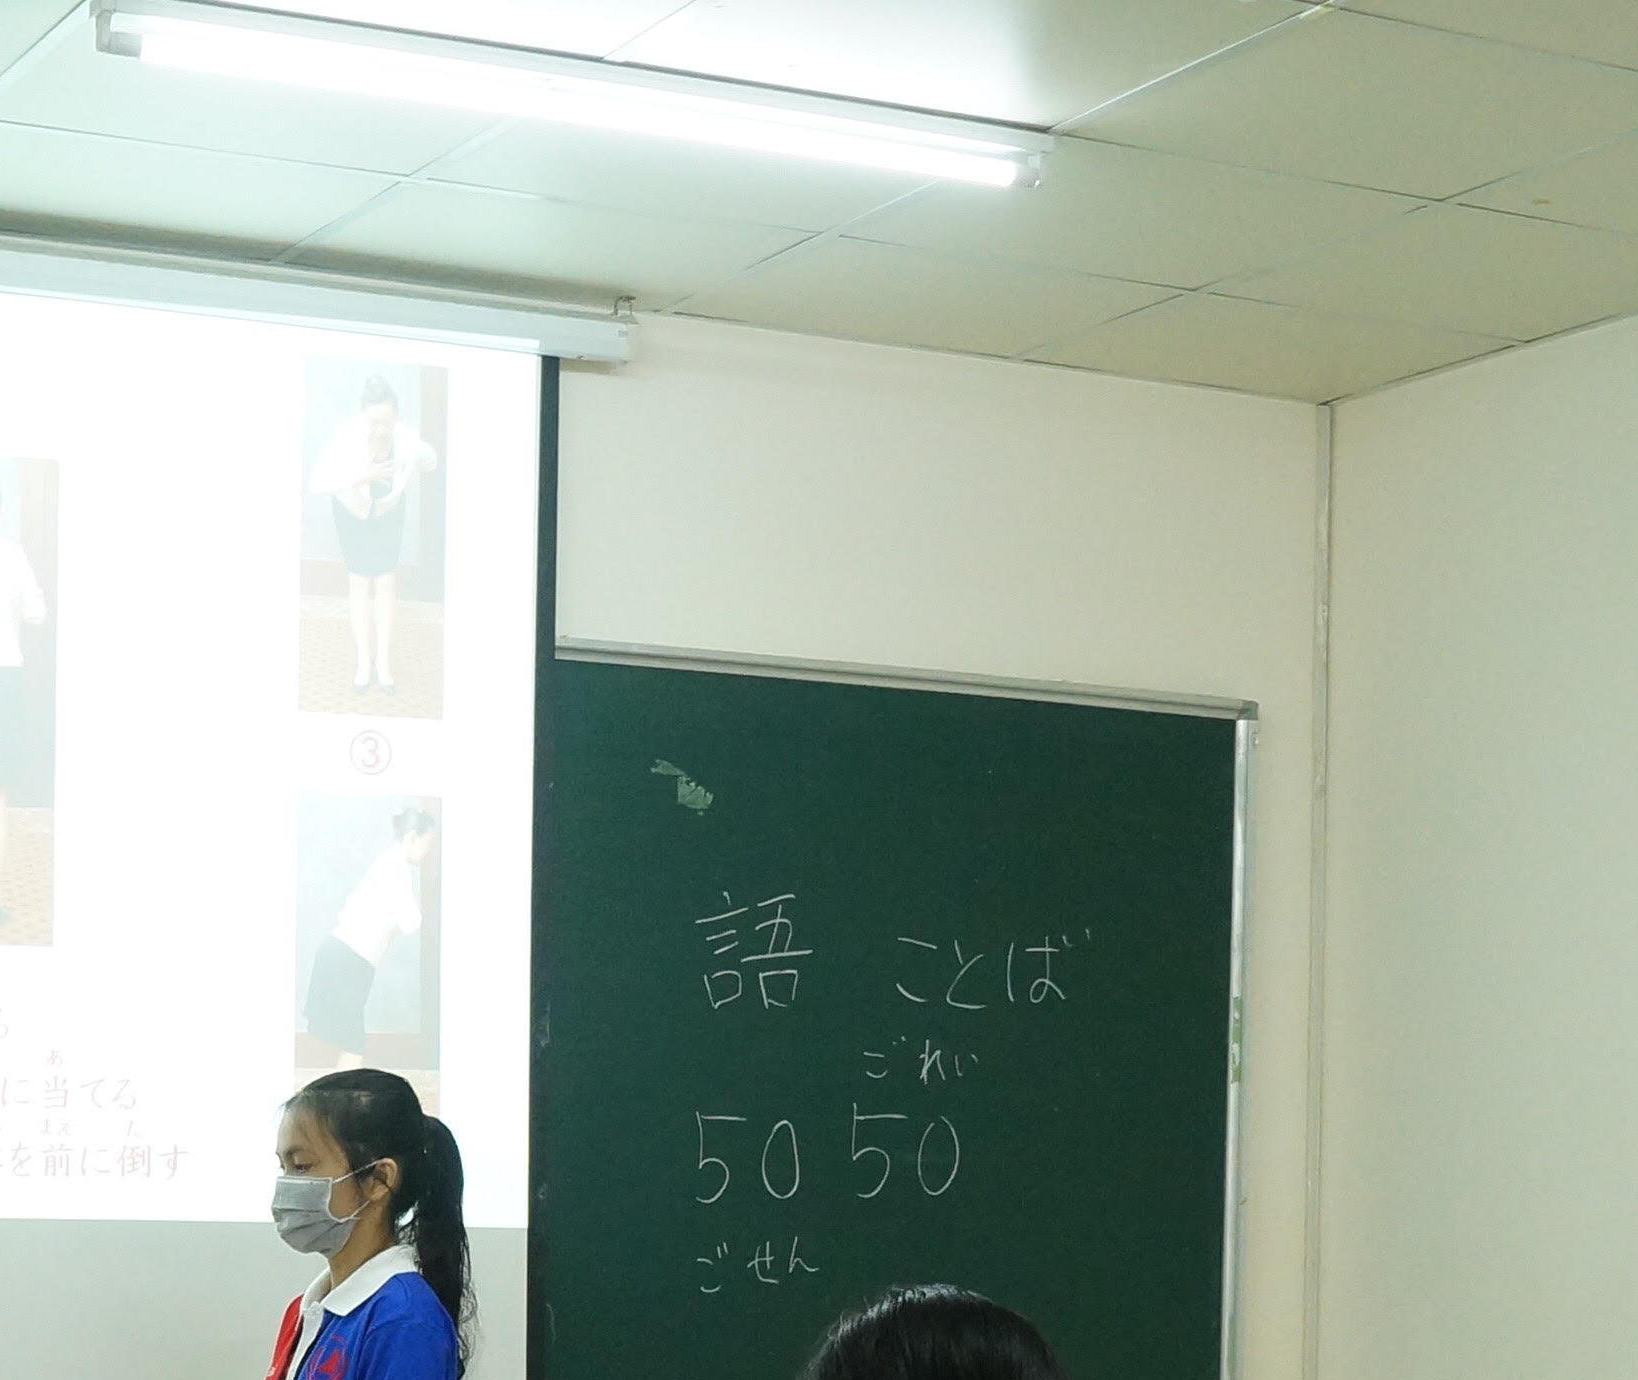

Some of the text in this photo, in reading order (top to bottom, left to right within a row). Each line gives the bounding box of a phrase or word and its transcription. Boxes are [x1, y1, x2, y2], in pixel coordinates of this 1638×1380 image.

[694, 889, 1093, 1011] 語 ことば
[696, 1235, 820, 1294] ごせん
